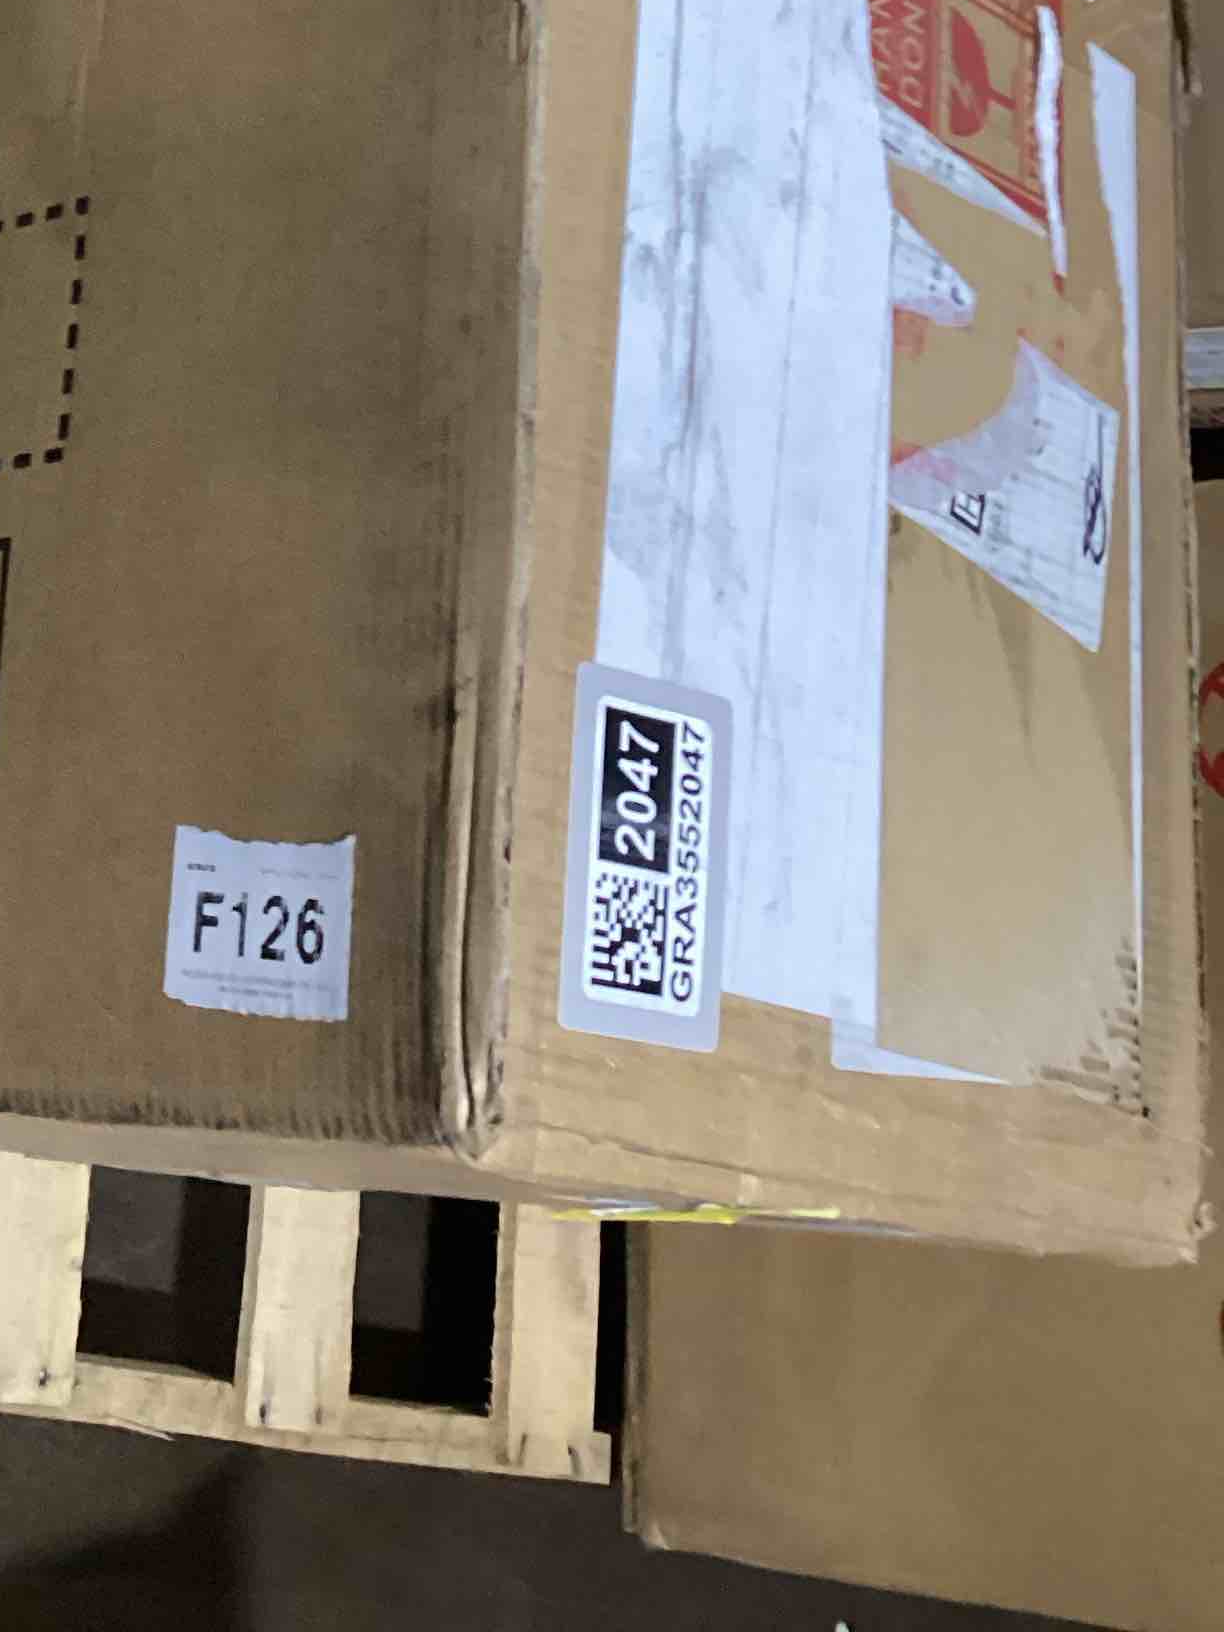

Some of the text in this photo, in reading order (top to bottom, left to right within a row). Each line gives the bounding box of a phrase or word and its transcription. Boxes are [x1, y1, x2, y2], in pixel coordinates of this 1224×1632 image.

[614, 719, 662, 863] 2047
[670, 720, 707, 1003] GRA3552047
[192, 890, 326, 966] F126
